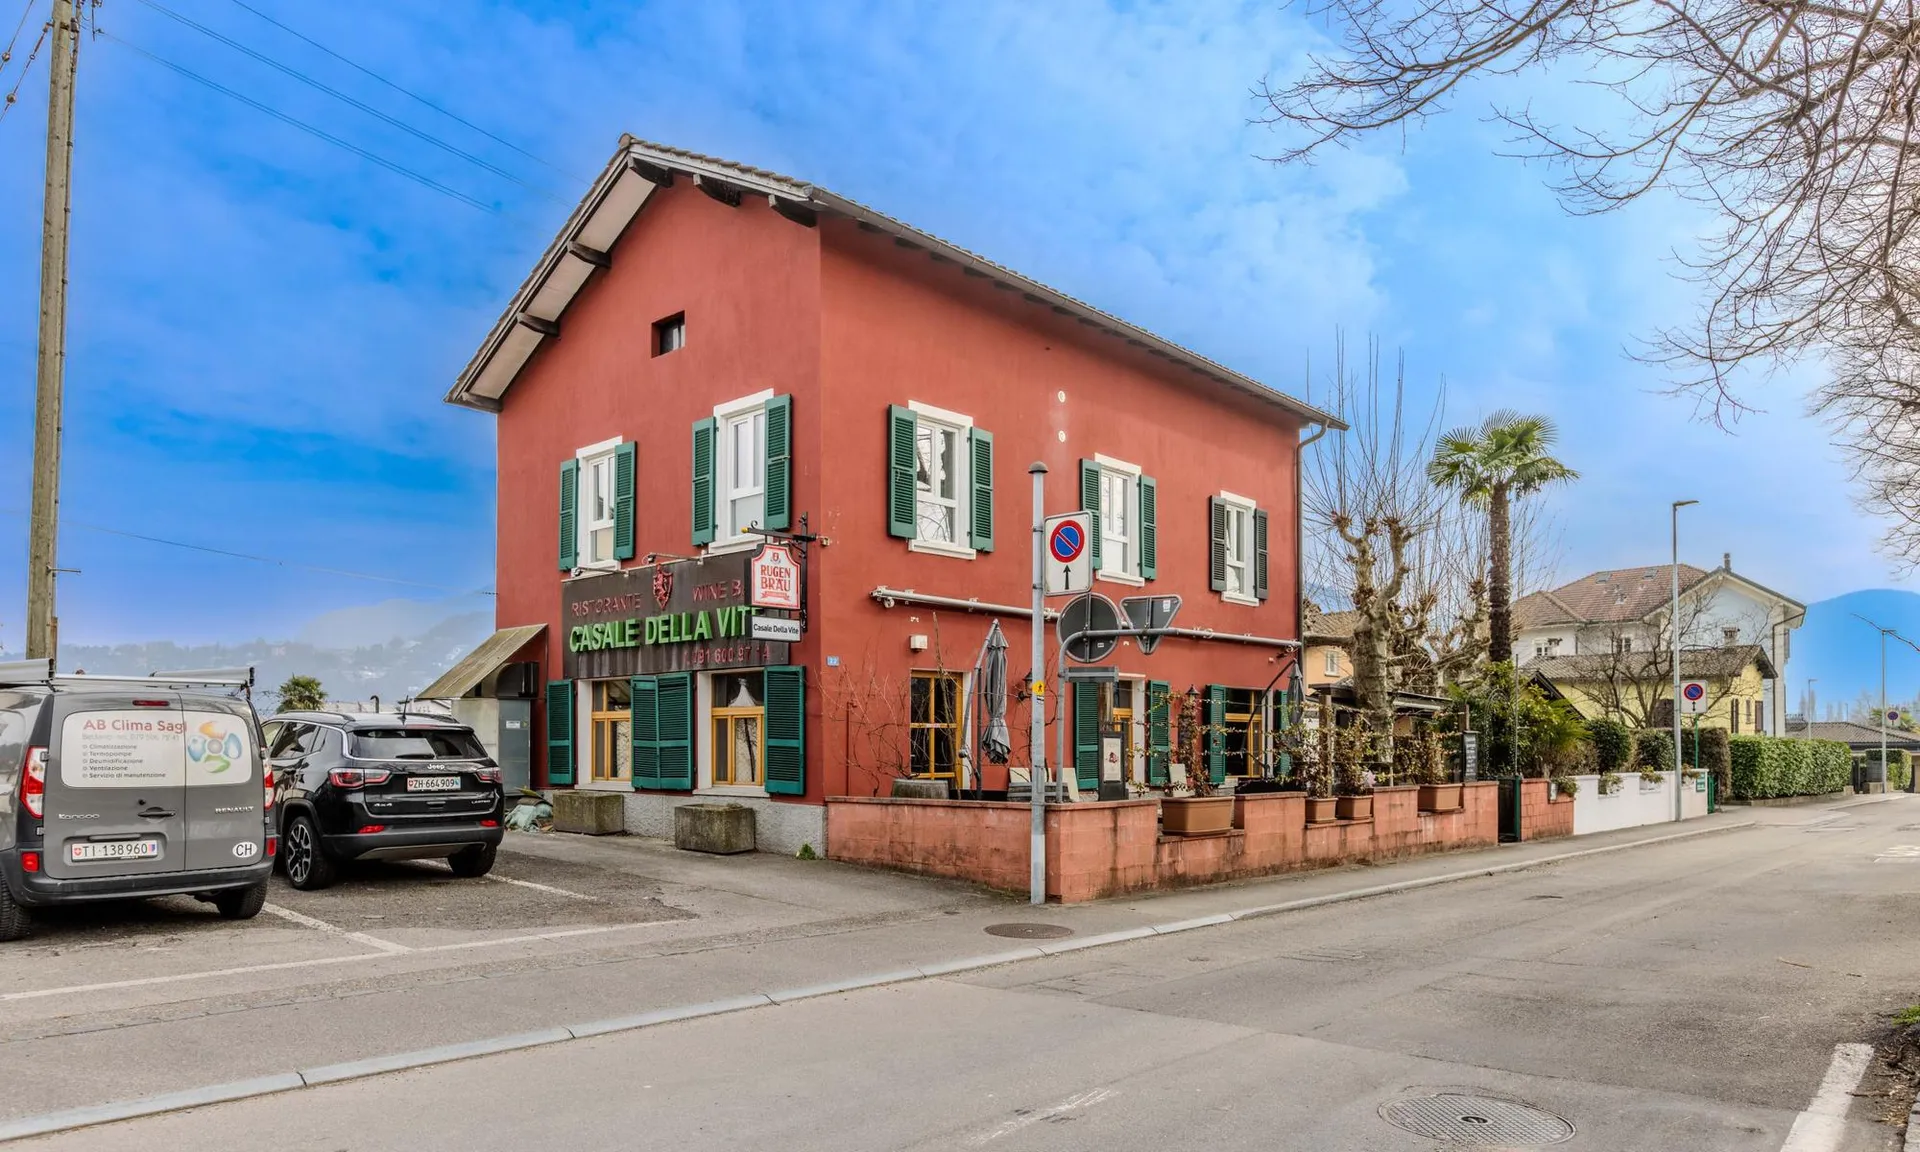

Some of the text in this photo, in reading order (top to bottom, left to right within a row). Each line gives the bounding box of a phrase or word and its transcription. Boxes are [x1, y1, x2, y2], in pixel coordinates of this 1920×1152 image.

[760, 564, 791, 578] RUGEN
[692, 581, 727, 601] WINE
[571, 592, 642, 617] RISTORANTE
[569, 618, 641, 652] CASALE
[644, 610, 713, 645] DELLA
[753, 623, 799, 635] Casale Della Vite
[714, 647, 734, 664] 600
[83, 719, 106, 731] AB
[111, 719, 153, 732] Clima
[427, 763, 446, 771] Jeep
[215, 805, 254, 814] RENAULT
[236, 843, 253, 857] CH
